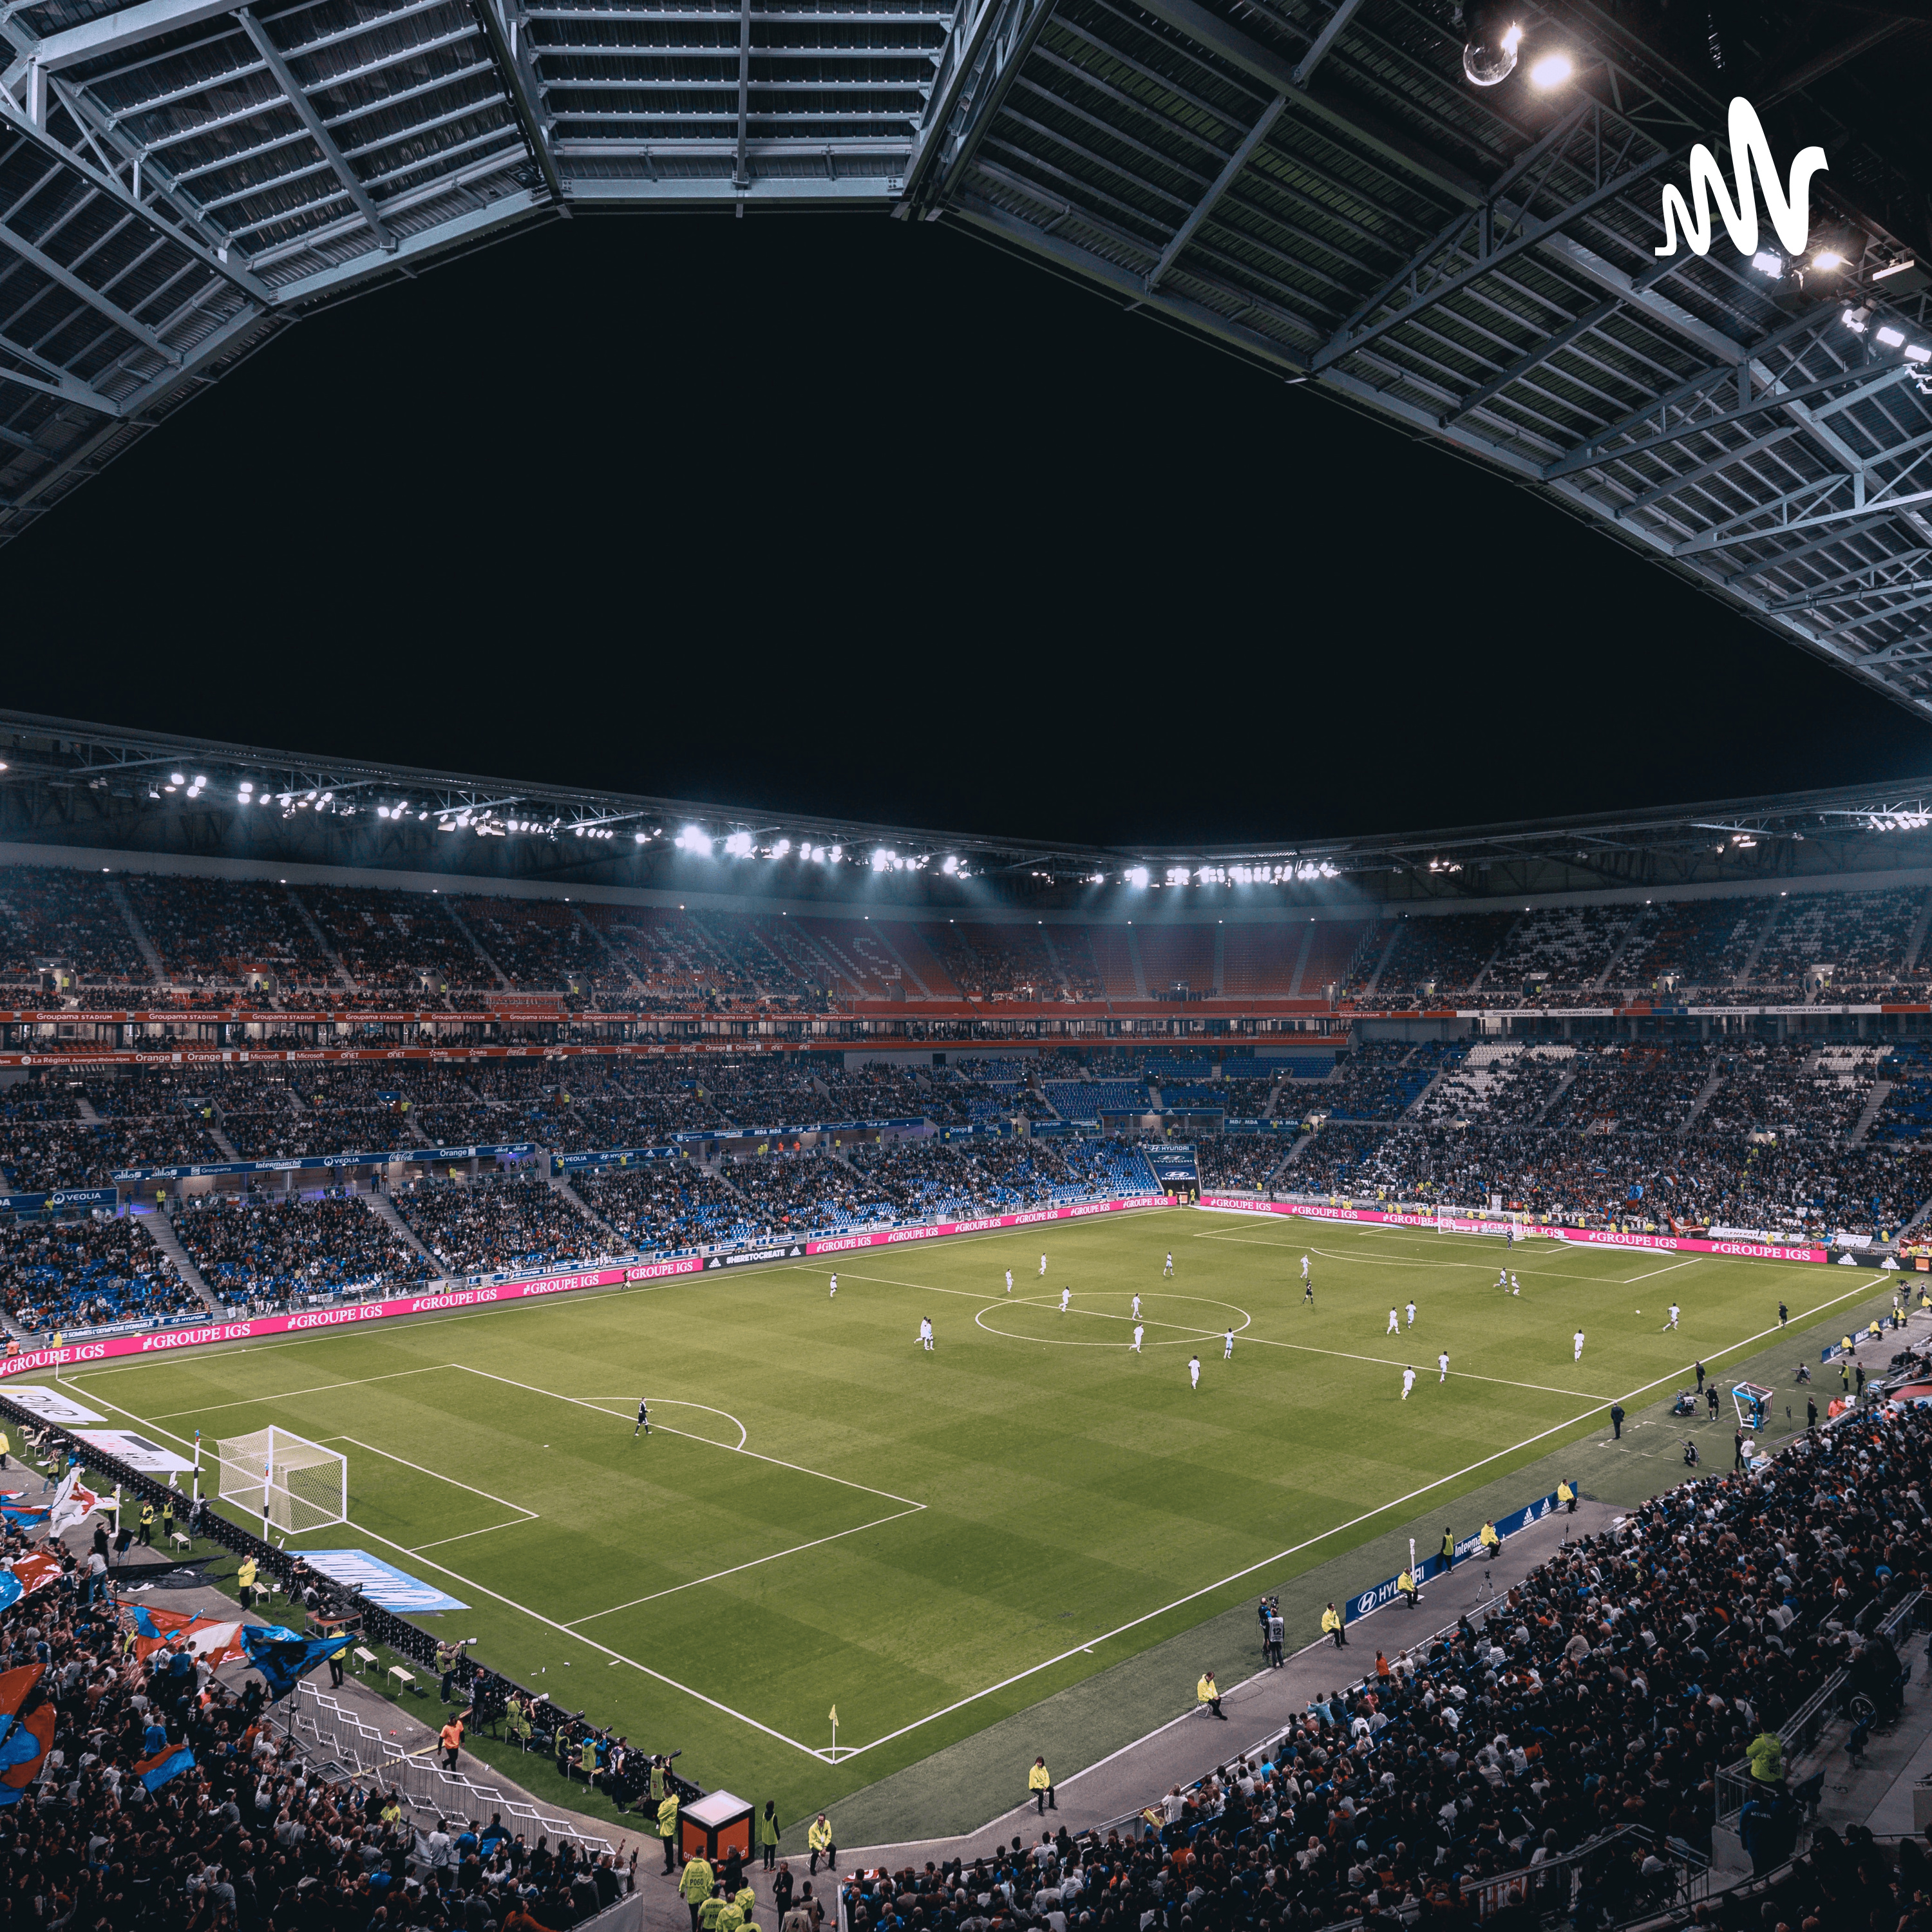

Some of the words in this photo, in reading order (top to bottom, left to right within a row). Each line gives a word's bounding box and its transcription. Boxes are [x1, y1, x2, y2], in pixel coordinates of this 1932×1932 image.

[135, 1054, 170, 1063] Orange
[389, 1151, 415, 1162] Coca-Cola
[440, 1149, 467, 1158] Orange
[256, 1159, 302, 1170] Intermarché
[1074, 1206, 1100, 1215] GROUPE
[1100, 1203, 1110, 1212] IGS
[1127, 1198, 1153, 1208] GROUPE
[1217, 1199, 1254, 1209] GROUPE
[1256, 1203, 1271, 1211] IGS
[1019, 1213, 1046, 1224] GROUPE
[1047, 1211, 1058, 1220] IGS
[1298, 1206, 1338, 1217] GROUPE
[1341, 1209, 1358, 1220] IGS
[960, 1220, 989, 1233] GROUPE
[990, 1218, 1001, 1227] IGS
[893, 1230, 925, 1242] GROUPE
[926, 1227, 938, 1236] IGS
[1596, 1233, 1651, 1246] GROUPE
[1655, 1237, 1677, 1248] IGS
[822, 1239, 857, 1252] GROUPE
[858, 1236, 871, 1247] IGS
[726, 1249, 785, 1265] #HERETOCREATE
[1721, 1243, 1781, 1258] GROUPE
[1785, 1249, 1811, 1261] IGS
[630, 1264, 674, 1279] GROUPE
[676, 1261, 693, 1273] IGS
[531, 1278, 578, 1294] GROUPE
[581, 1275, 599, 1287] IGS
[421, 1292, 474, 1310] GROUPE
[477, 1289, 497, 1302] IGS
[182, 1314, 206, 1322] HYUNDAI
[296, 1309, 356, 1329] GROUPE
[360, 1305, 383, 1319] IGS
[153, 1327, 220, 1349] GROUPE
[224, 1323, 251, 1338] IGS
[6, 1349, 71, 1368] GROUPE
[75, 1344, 104, 1360] IGS
[1541, 1506, 1551, 1516] adidas
[1523, 1516, 1534, 1526] adidas
[187, 1713, 196, 1722] 73
[792, 1917, 799, 1929] 4
